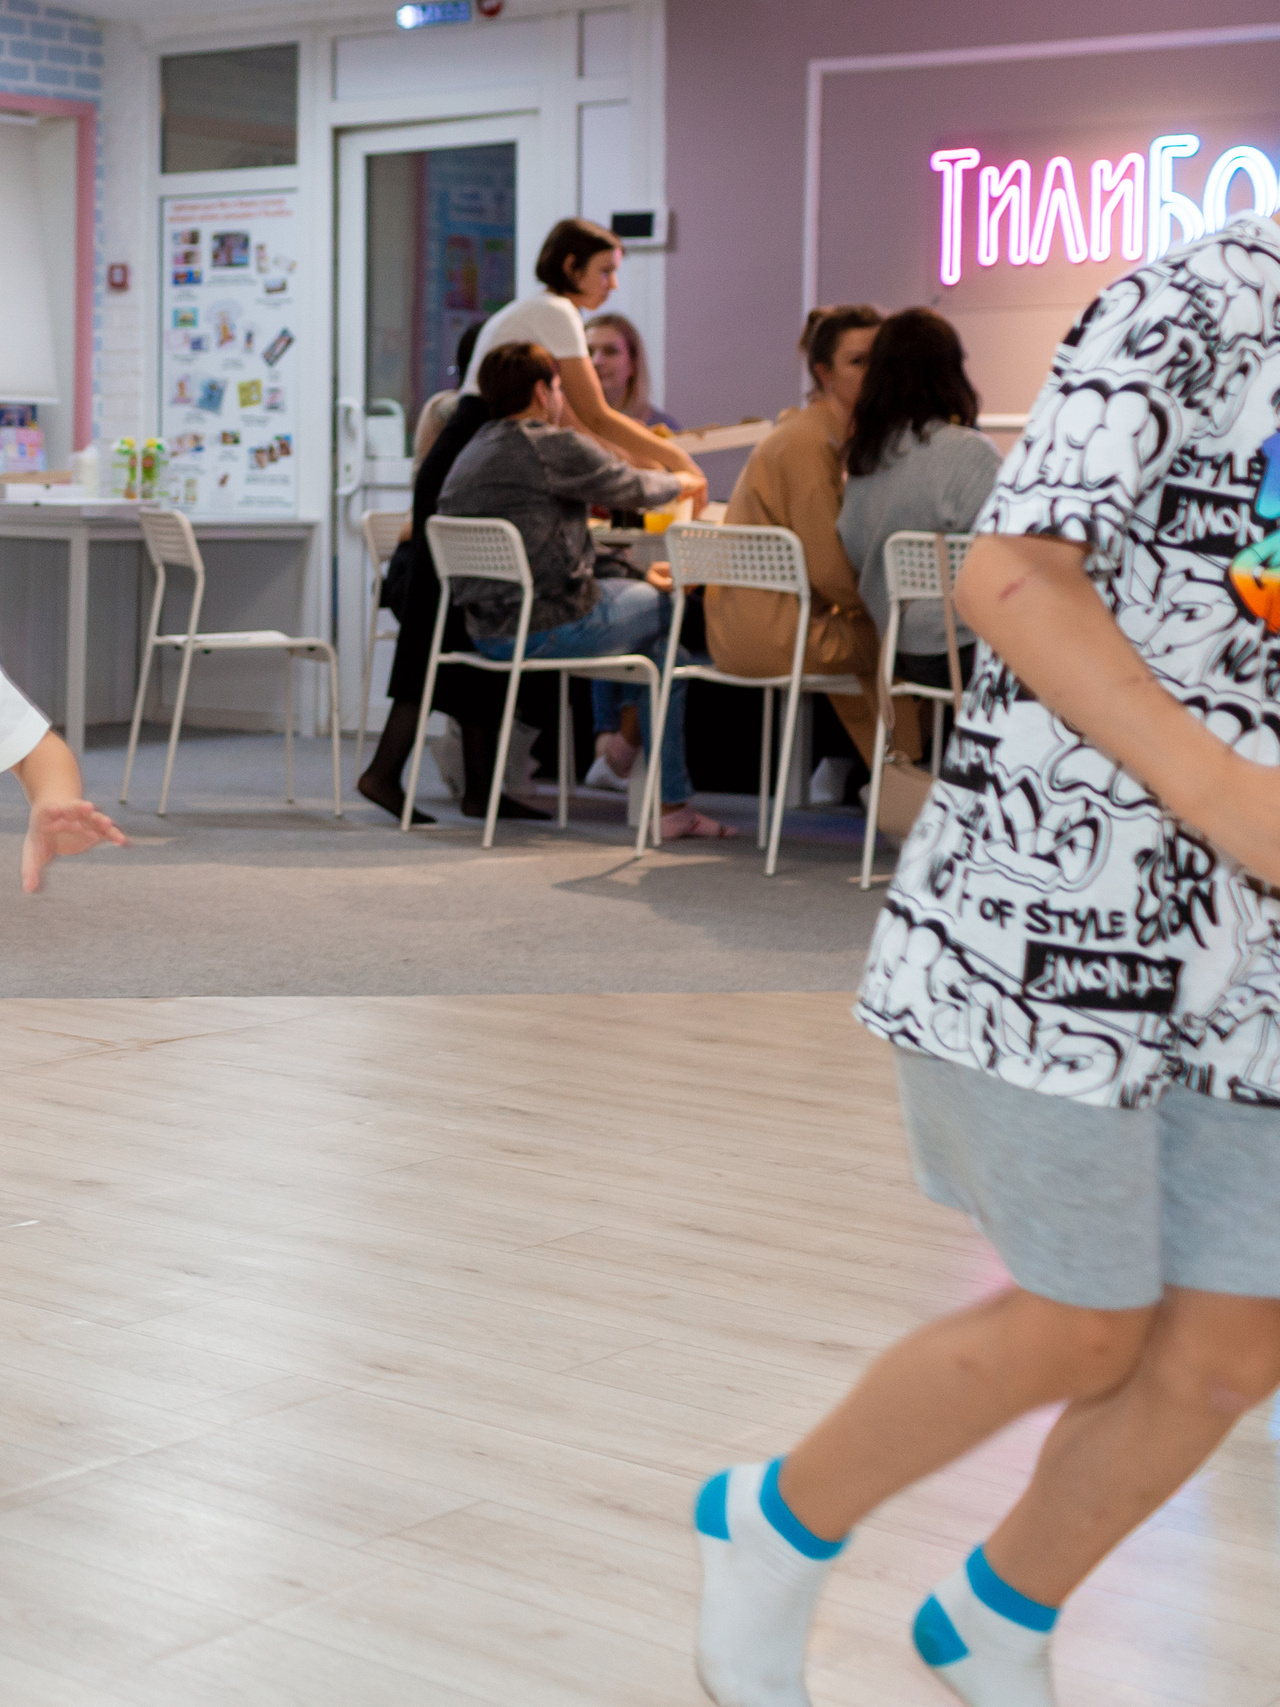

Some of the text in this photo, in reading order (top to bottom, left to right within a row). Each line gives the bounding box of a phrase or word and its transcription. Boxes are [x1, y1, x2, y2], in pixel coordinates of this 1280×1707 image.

[1168, 444, 1267, 488] STYLE
[979, 897, 1128, 944] OF STYLE
